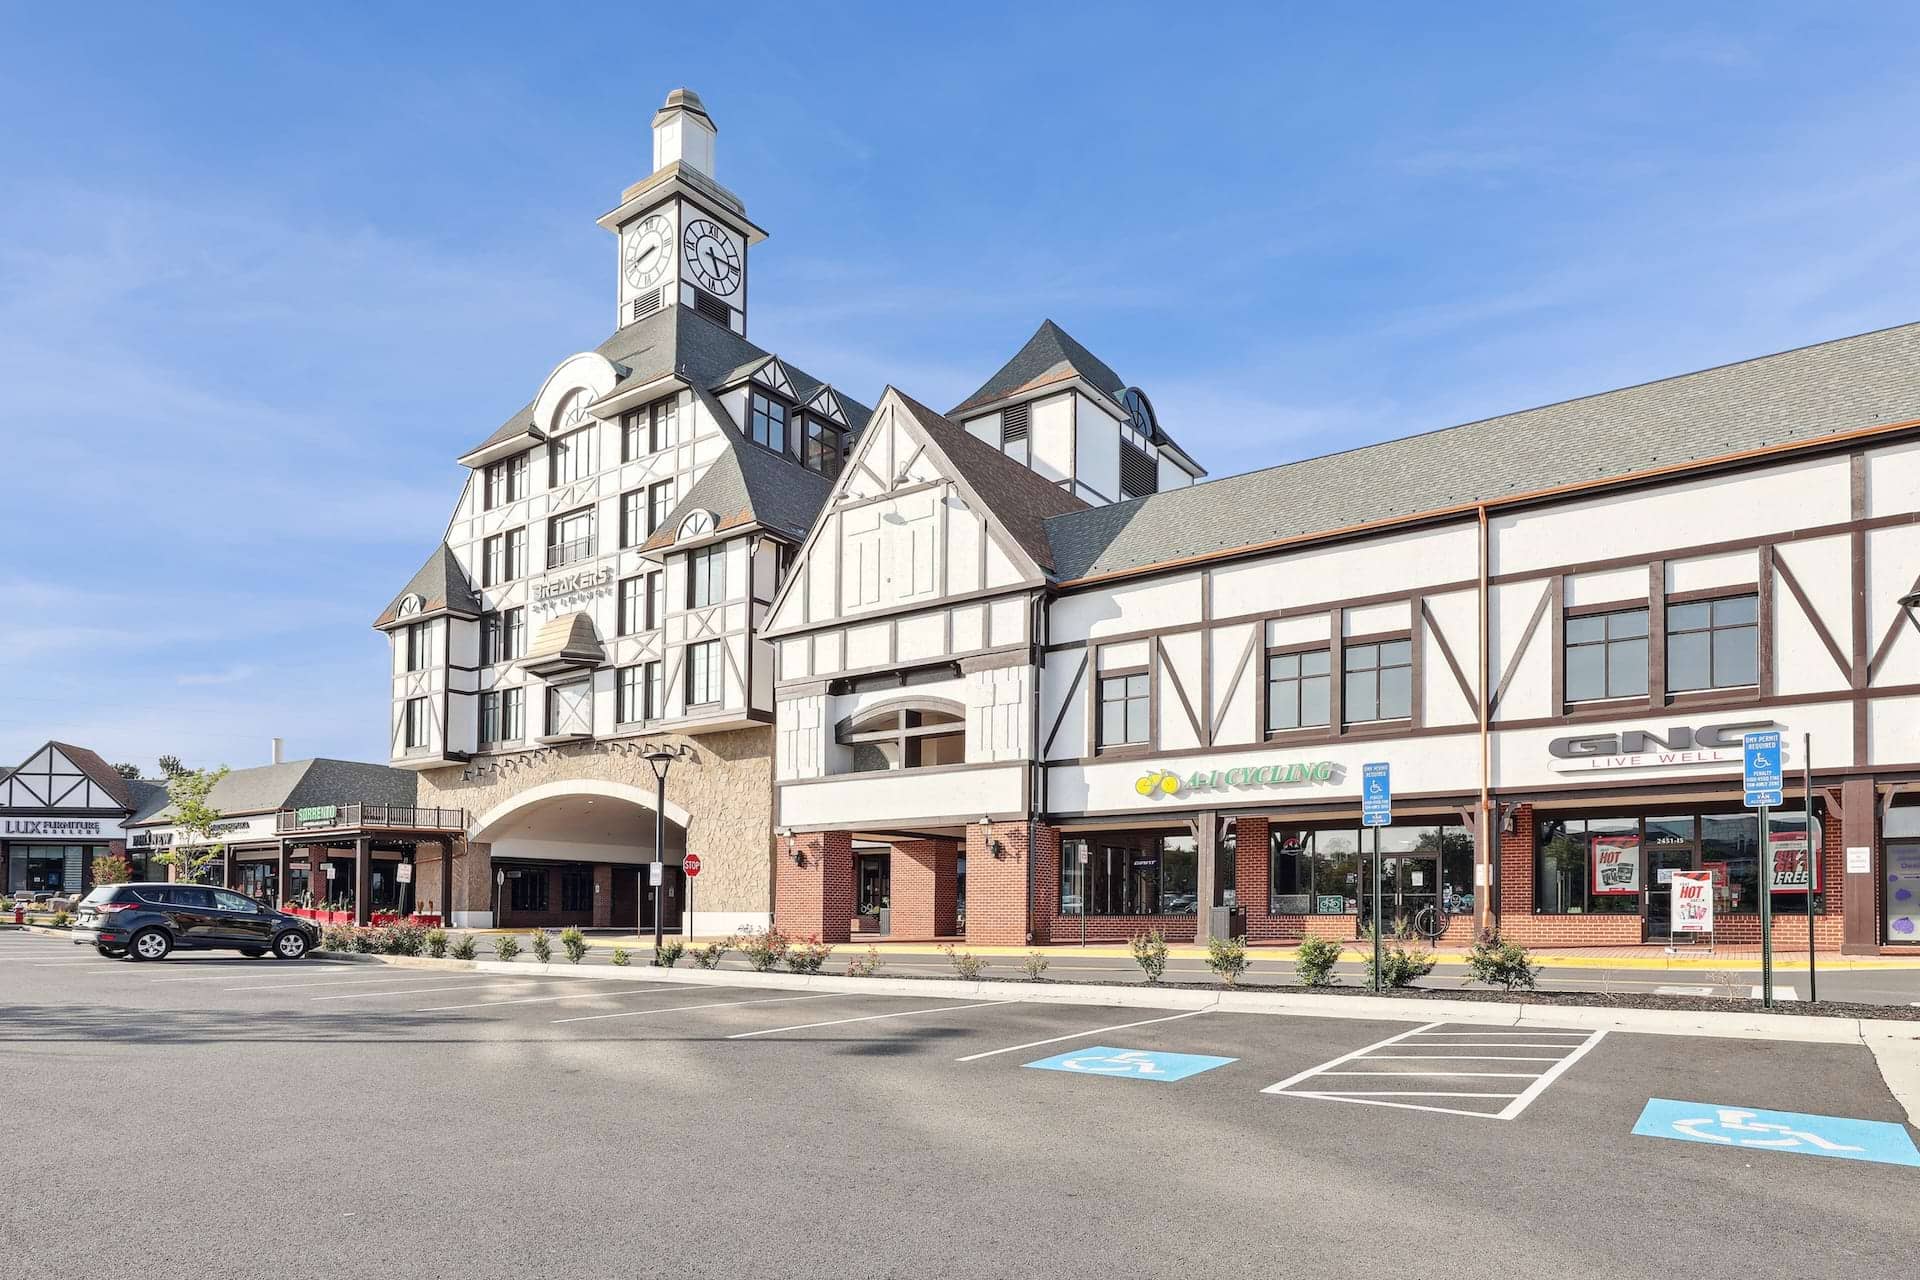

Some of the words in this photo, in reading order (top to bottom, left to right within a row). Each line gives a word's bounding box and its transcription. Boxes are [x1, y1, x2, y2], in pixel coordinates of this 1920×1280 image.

[1548, 719, 1774, 758] GNC
[1592, 756, 1641, 768] LIVE
[1660, 751, 1724, 764] WELL
[1184, 769, 1218, 790] A-1
[1224, 761, 1331, 786] CYCLING
[298, 805, 337, 821] SORRENTO
[5, 820, 41, 834] LUX
[43, 821, 100, 829] FURNITURE
[1599, 851, 1622, 864] HOT
[684, 860, 701, 870] STOP
[1773, 871, 1809, 885] FREE
[1679, 885, 1704, 899] HOT
